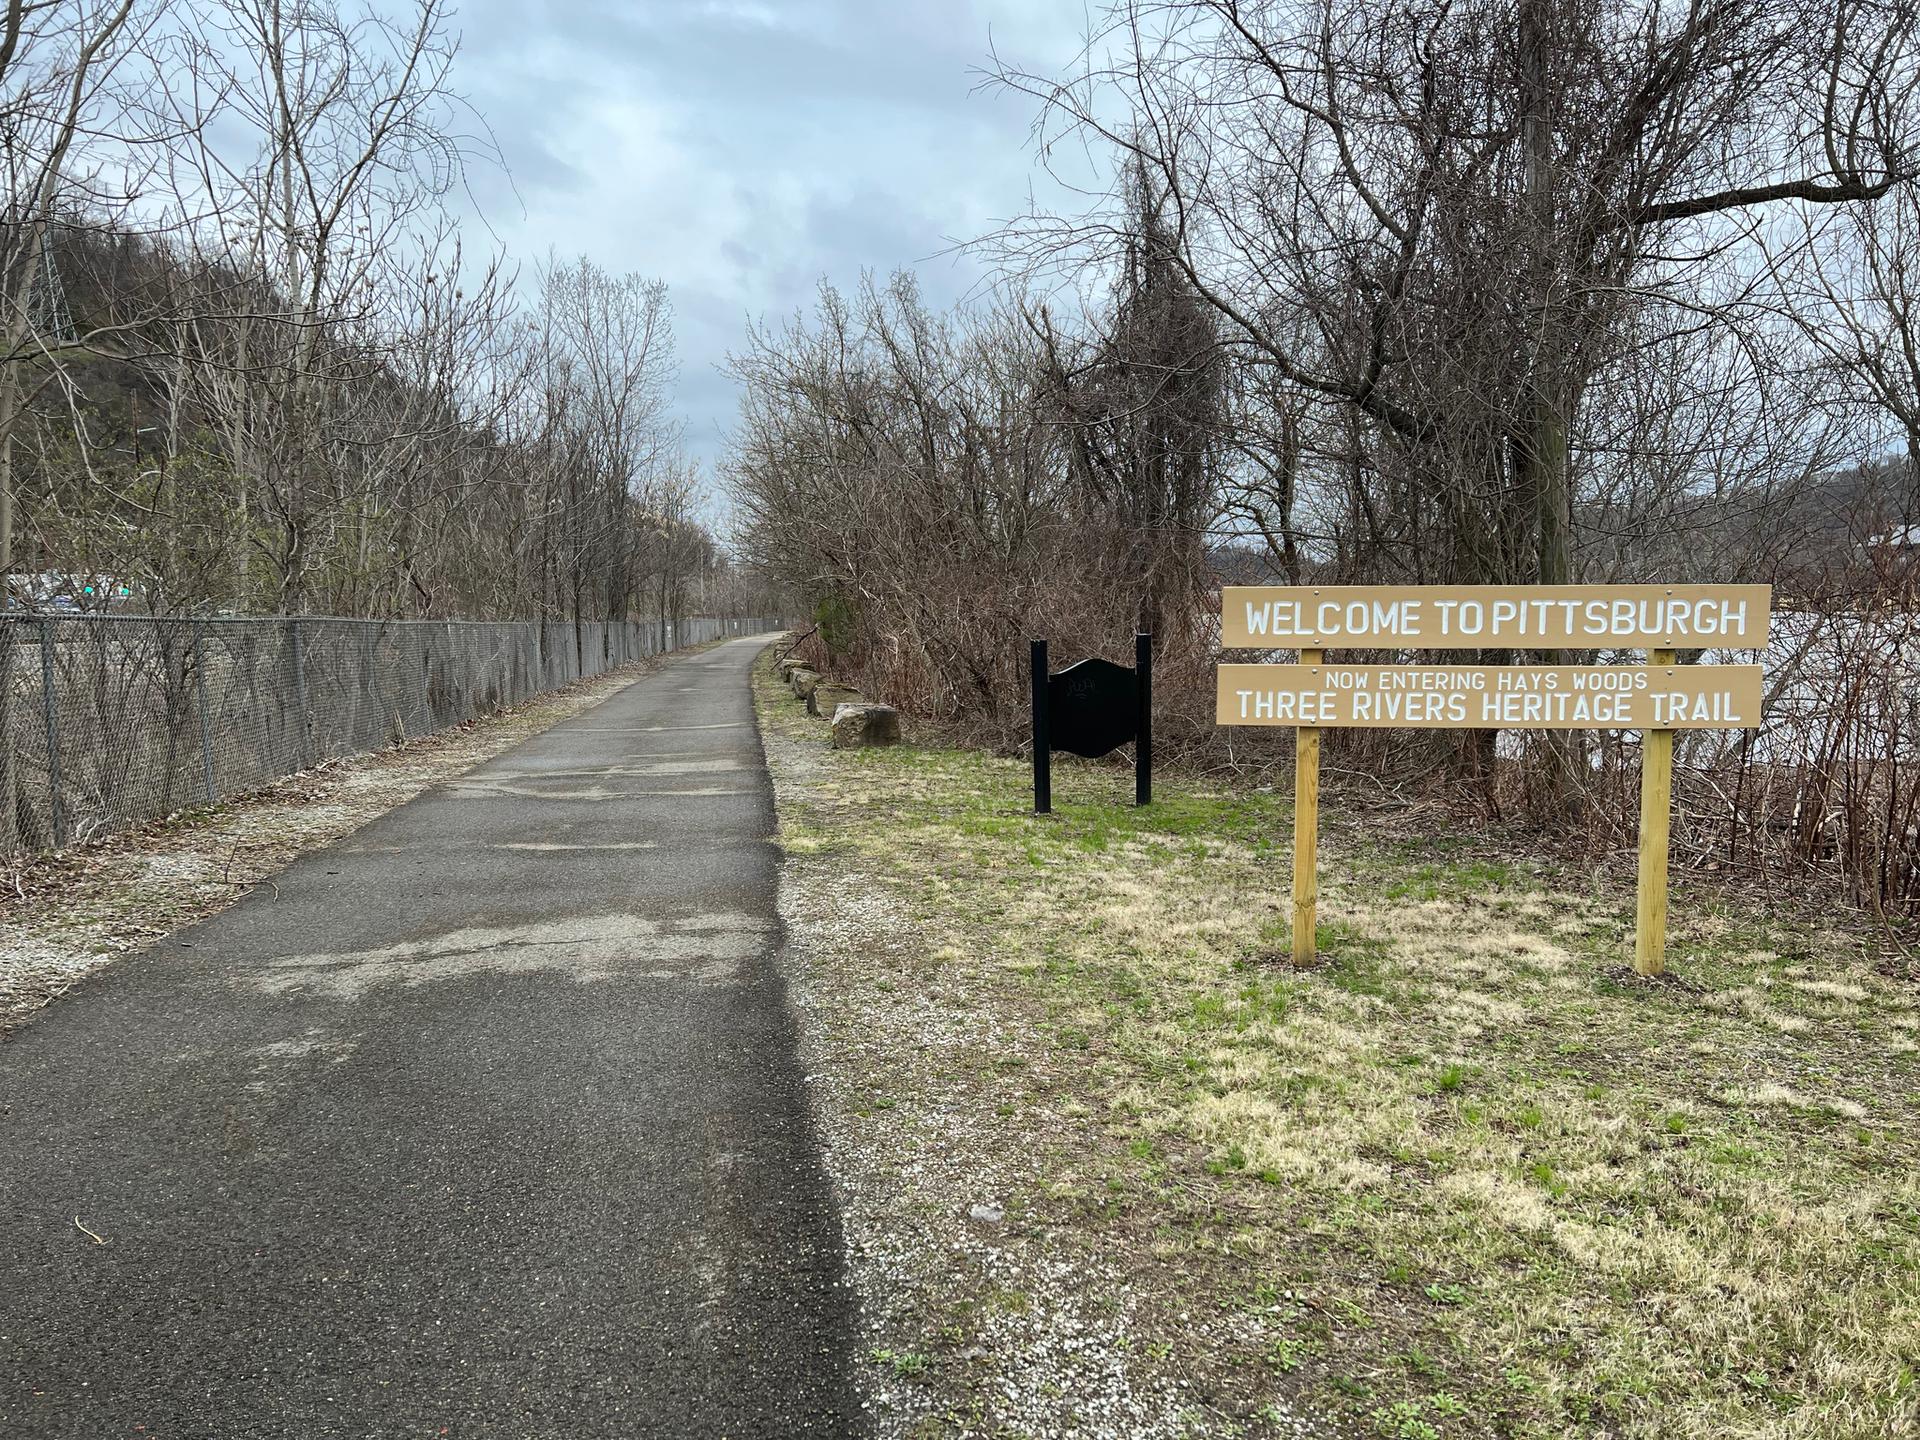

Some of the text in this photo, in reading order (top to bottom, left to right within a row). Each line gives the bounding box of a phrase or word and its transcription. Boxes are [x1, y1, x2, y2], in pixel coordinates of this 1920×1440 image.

[1246, 599, 1747, 636] WELCOME TO PITTSBURGH
[1325, 671, 1648, 691] NOW ENTERING HAYS WOODS
[1235, 690, 1742, 722] THREE RIVERS HERITAGE TRAIL
